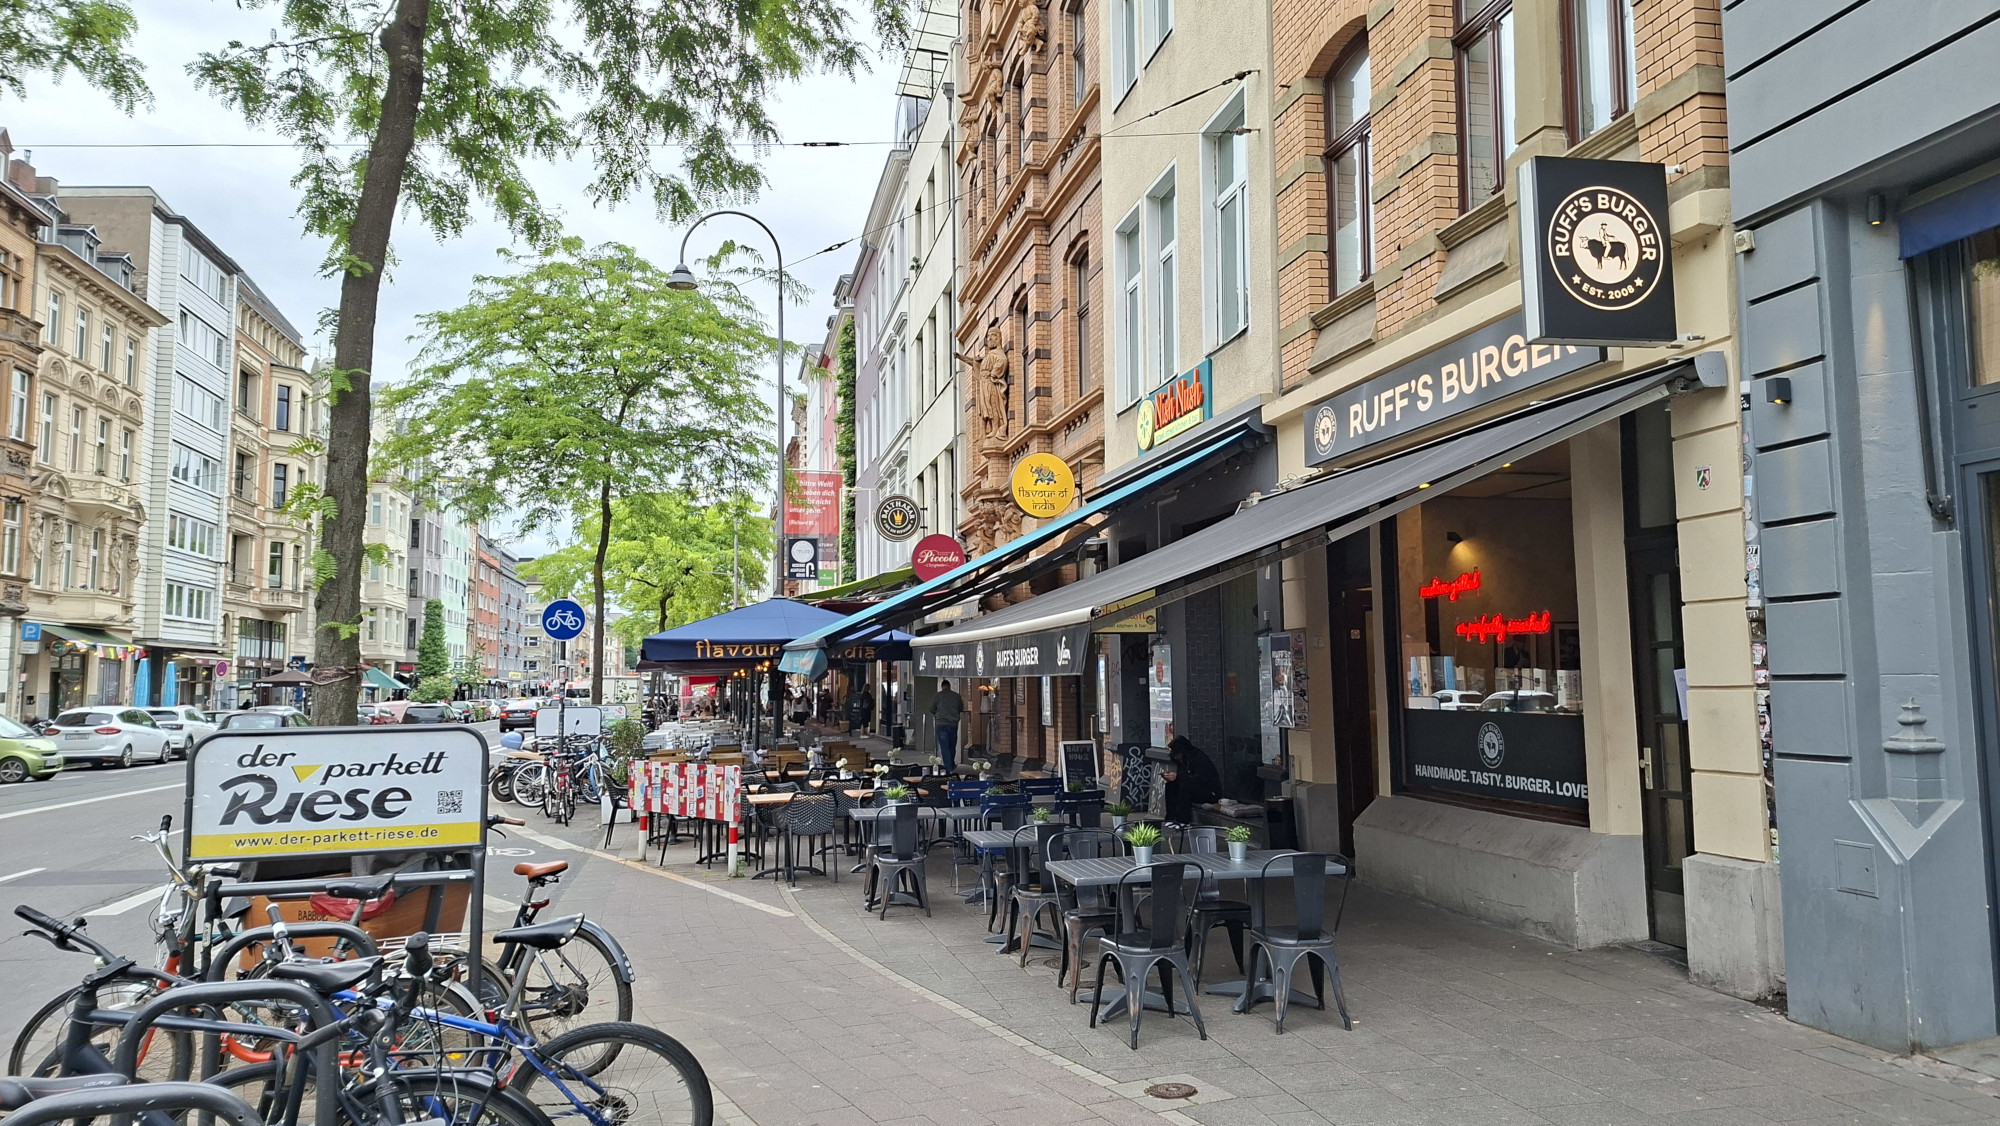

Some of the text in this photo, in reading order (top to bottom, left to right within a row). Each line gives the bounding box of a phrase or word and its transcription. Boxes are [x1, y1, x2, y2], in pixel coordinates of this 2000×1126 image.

[1555, 193, 1657, 261] RUFF'S BURGER
[1581, 283, 1635, 300] EST. 2008
[1349, 374, 1433, 439] RUFF'S
[1018, 486, 1069, 498] flavour of
[881, 500, 916, 520] BALTHASAR
[1032, 499, 1056, 511] india
[917, 550, 959, 564] Piccola
[695, 639, 781, 658] flavour
[1014, 646, 1039, 667] BURGER
[237, 744, 297, 768] der
[320, 751, 449, 786] parkett
[1415, 764, 1470, 783] HANDMADE.
[1470, 770, 1504, 788] TASTY.
[1505, 775, 1554, 795] BURGER.
[234, 827, 439, 847] www.der-parkett-riese.de
